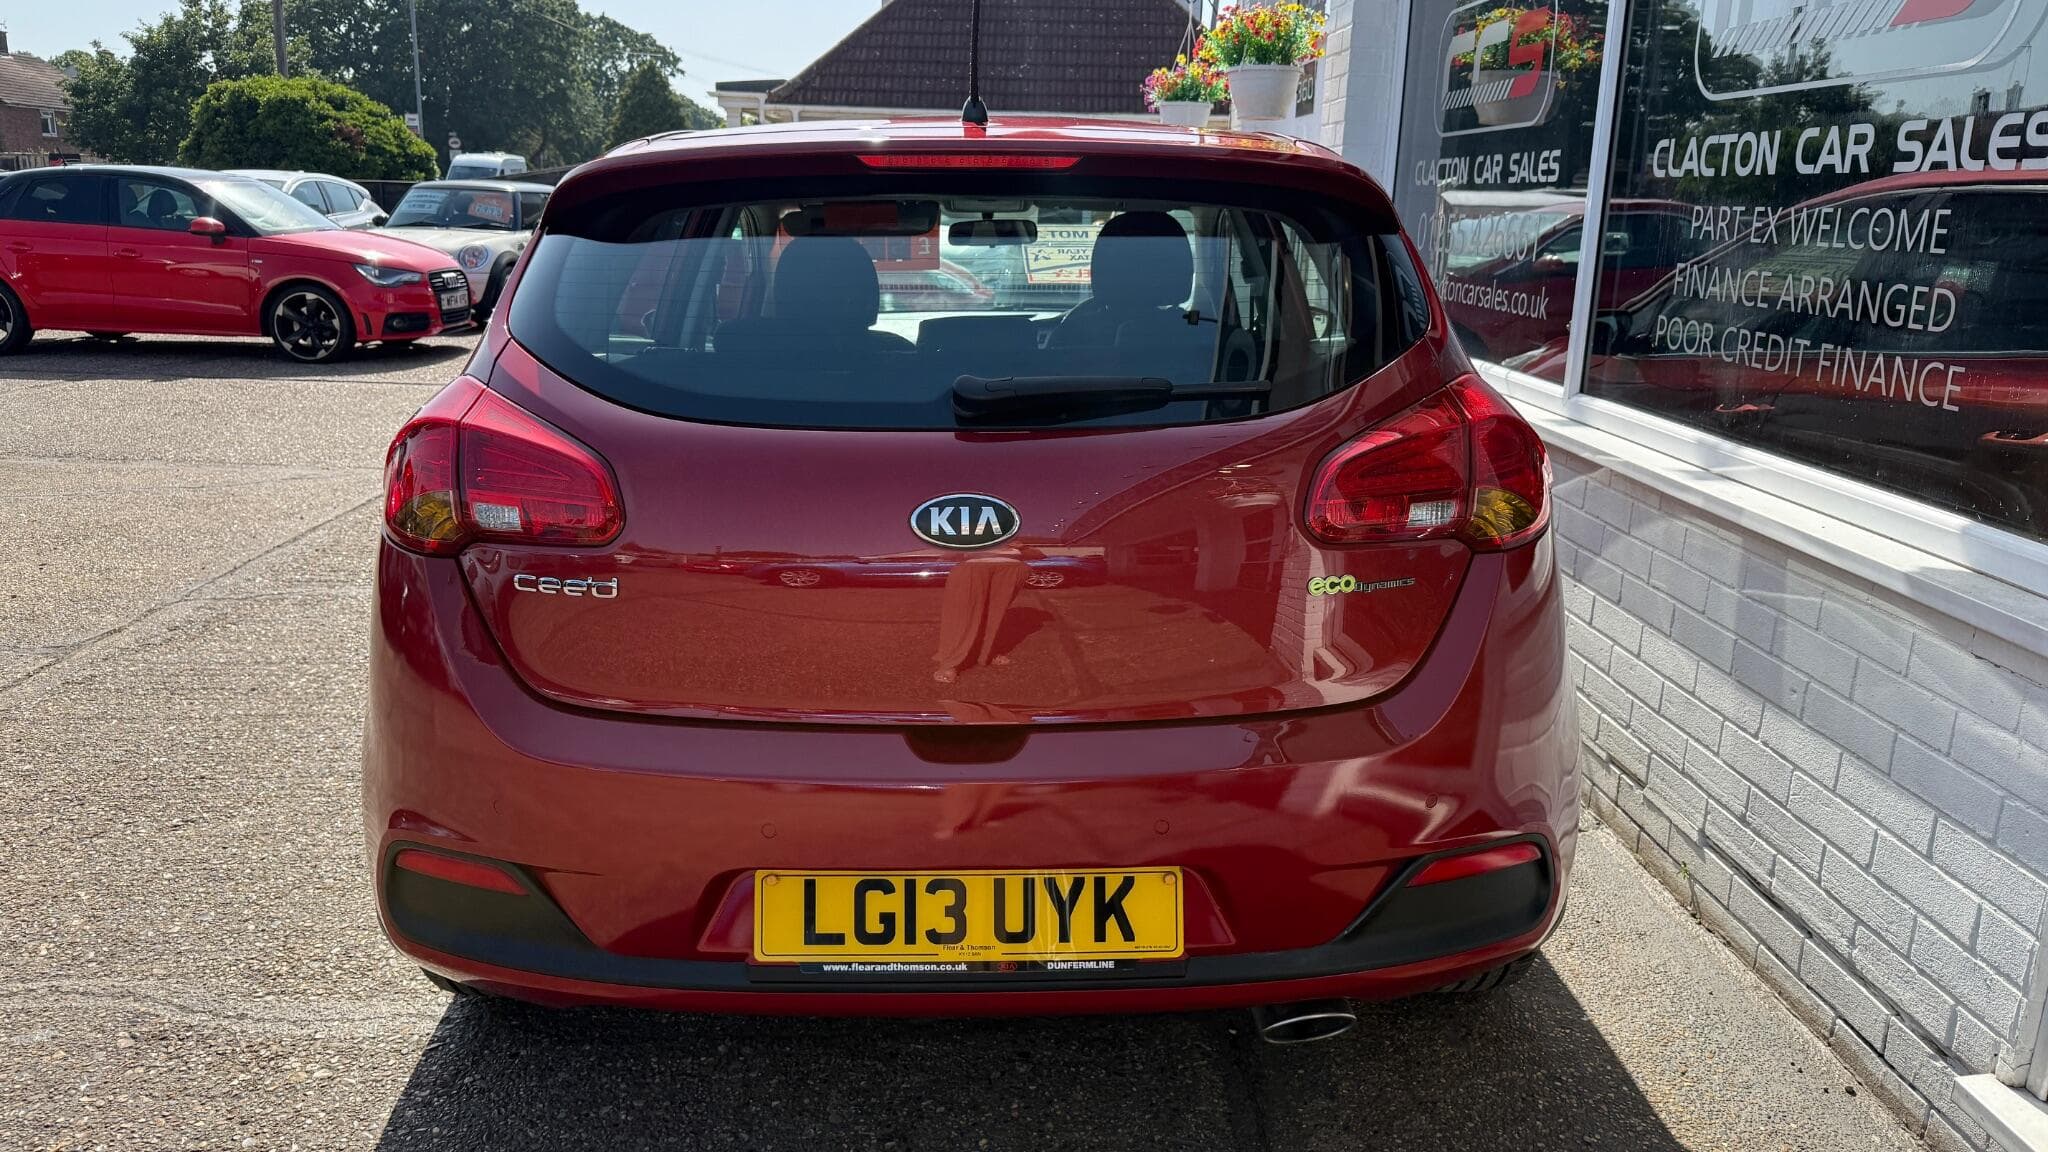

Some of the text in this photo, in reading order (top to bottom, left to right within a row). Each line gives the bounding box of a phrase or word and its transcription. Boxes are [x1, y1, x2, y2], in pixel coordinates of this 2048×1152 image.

[1415, 149, 1562, 186] CLACTON CAR SALES
[1652, 110, 2048, 178] CLACTON CAR SALES
[1690, 205, 1952, 255] PART EX WELCOME
[1672, 262, 1956, 333] FINANCE ARRANGED
[1654, 315, 1966, 412] POOR CREDIT FINANCE
[929, 506, 1003, 536] KIA
[803, 876, 1136, 945] LG13 UYK
[822, 962, 968, 972] www.flearandthomson.co.uk
[1047, 960, 1116, 970] DUNFERMLINE
